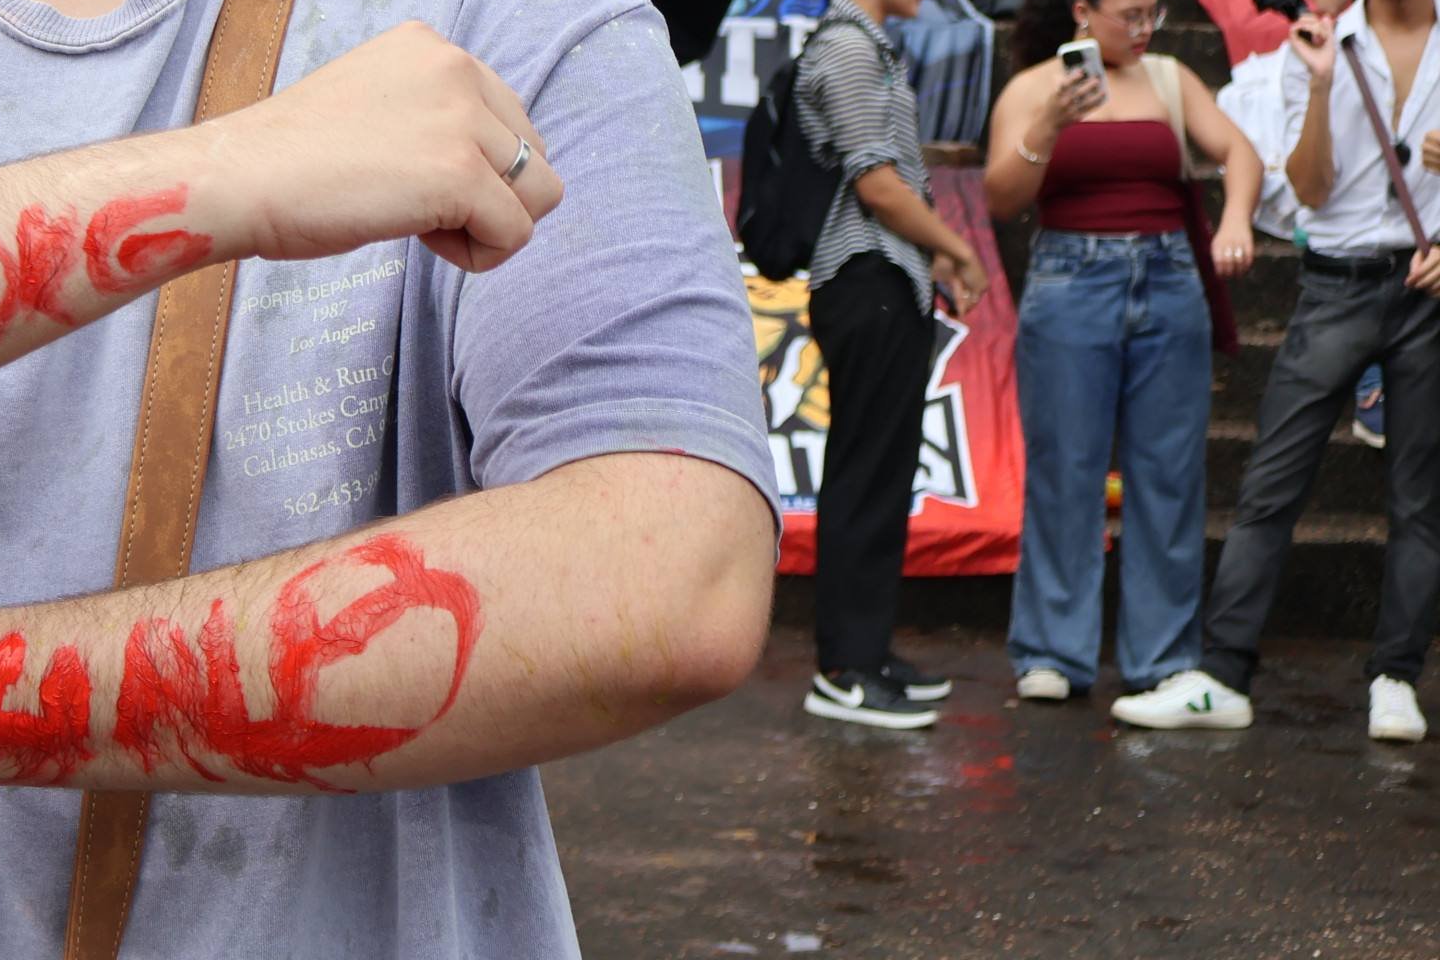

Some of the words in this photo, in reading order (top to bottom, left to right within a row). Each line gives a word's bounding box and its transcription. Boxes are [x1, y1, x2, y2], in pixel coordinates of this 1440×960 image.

[239, 289, 304, 315] SPORTS
[312, 299, 349, 322] 1987
[289, 335, 315, 355] Los
[319, 318, 376, 344] Angeles
[242, 381, 310, 416] Health
[314, 376, 333, 396] &
[336, 366, 379, 389] Run
[224, 421, 272, 451] 2470
[276, 408, 336, 438] Stokes
[243, 440, 342, 478] Calabasas,
[346, 424, 377, 449] CA
